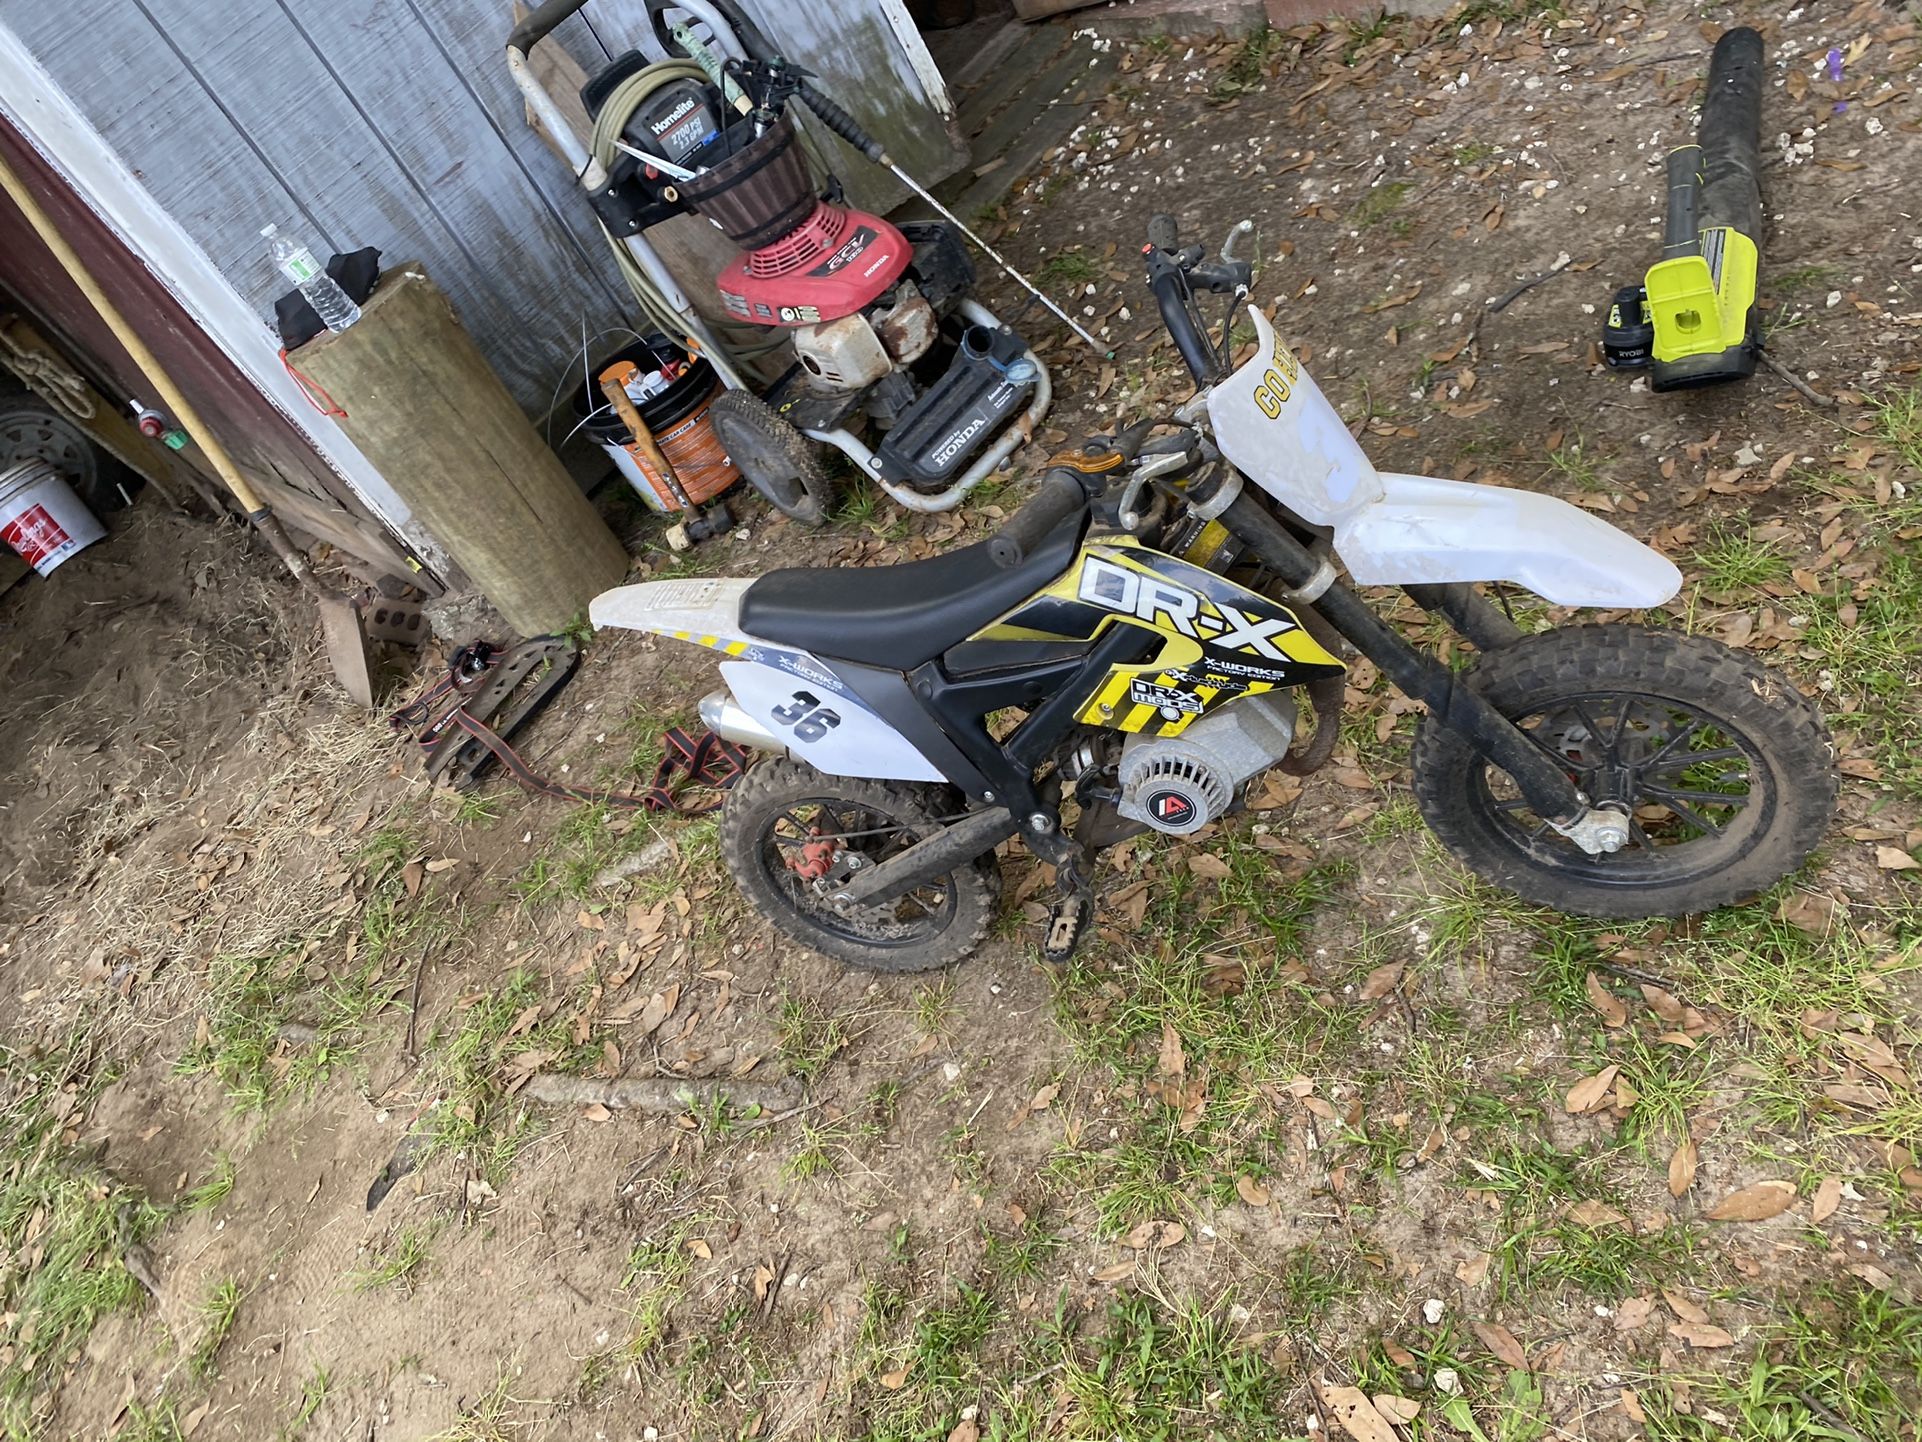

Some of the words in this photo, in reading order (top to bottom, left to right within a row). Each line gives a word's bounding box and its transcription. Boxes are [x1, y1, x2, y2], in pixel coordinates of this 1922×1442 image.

[650, 99, 695, 135] Homelite
[671, 124, 691, 145] 2700
[690, 116, 702, 131] PSI
[829, 233, 865, 269] GCV
[863, 254, 889, 277] HONDA
[1618, 348, 1645, 358] RYOBI
[935, 418, 986, 467] HONDA
[1079, 556, 1296, 663] DR-X
[778, 655, 844, 690] X-WORKS
[1204, 656, 1286, 679] X-WORKS
[1207, 665, 1246, 676] FACTORY
[1132, 680, 1197, 703] DR-X
[771, 691, 841, 743] 36
